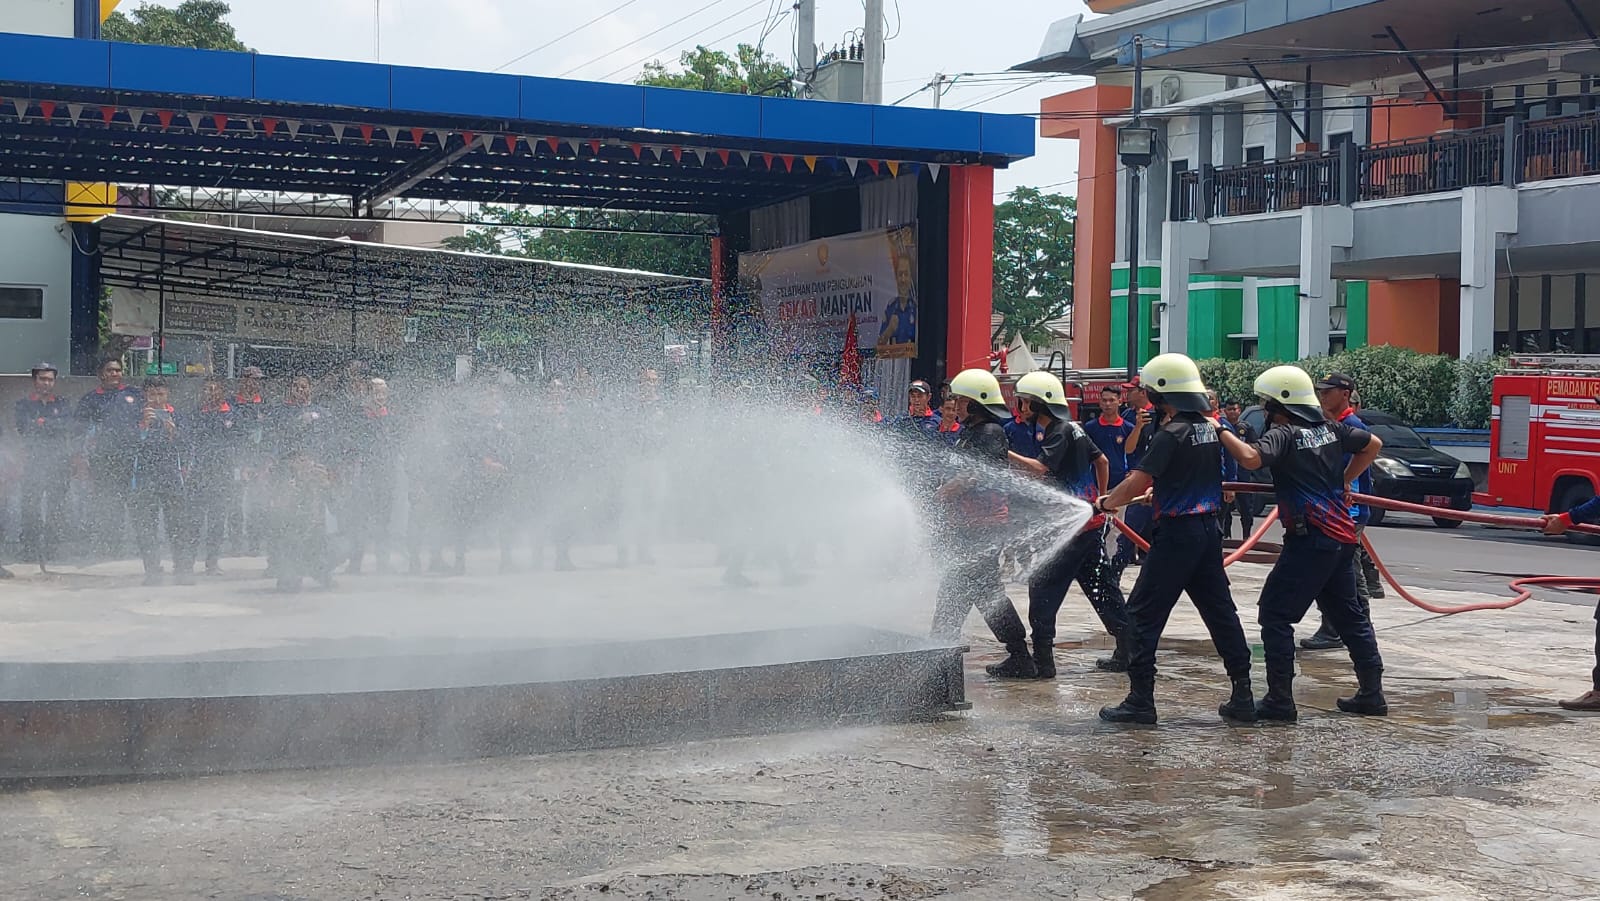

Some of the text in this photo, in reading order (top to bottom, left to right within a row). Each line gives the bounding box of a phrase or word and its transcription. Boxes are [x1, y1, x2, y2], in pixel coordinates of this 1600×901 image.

[819, 291, 873, 318] MANTAN
[1547, 380, 1600, 397] PEMADAM KE
[1498, 462, 1518, 474] UNIT
